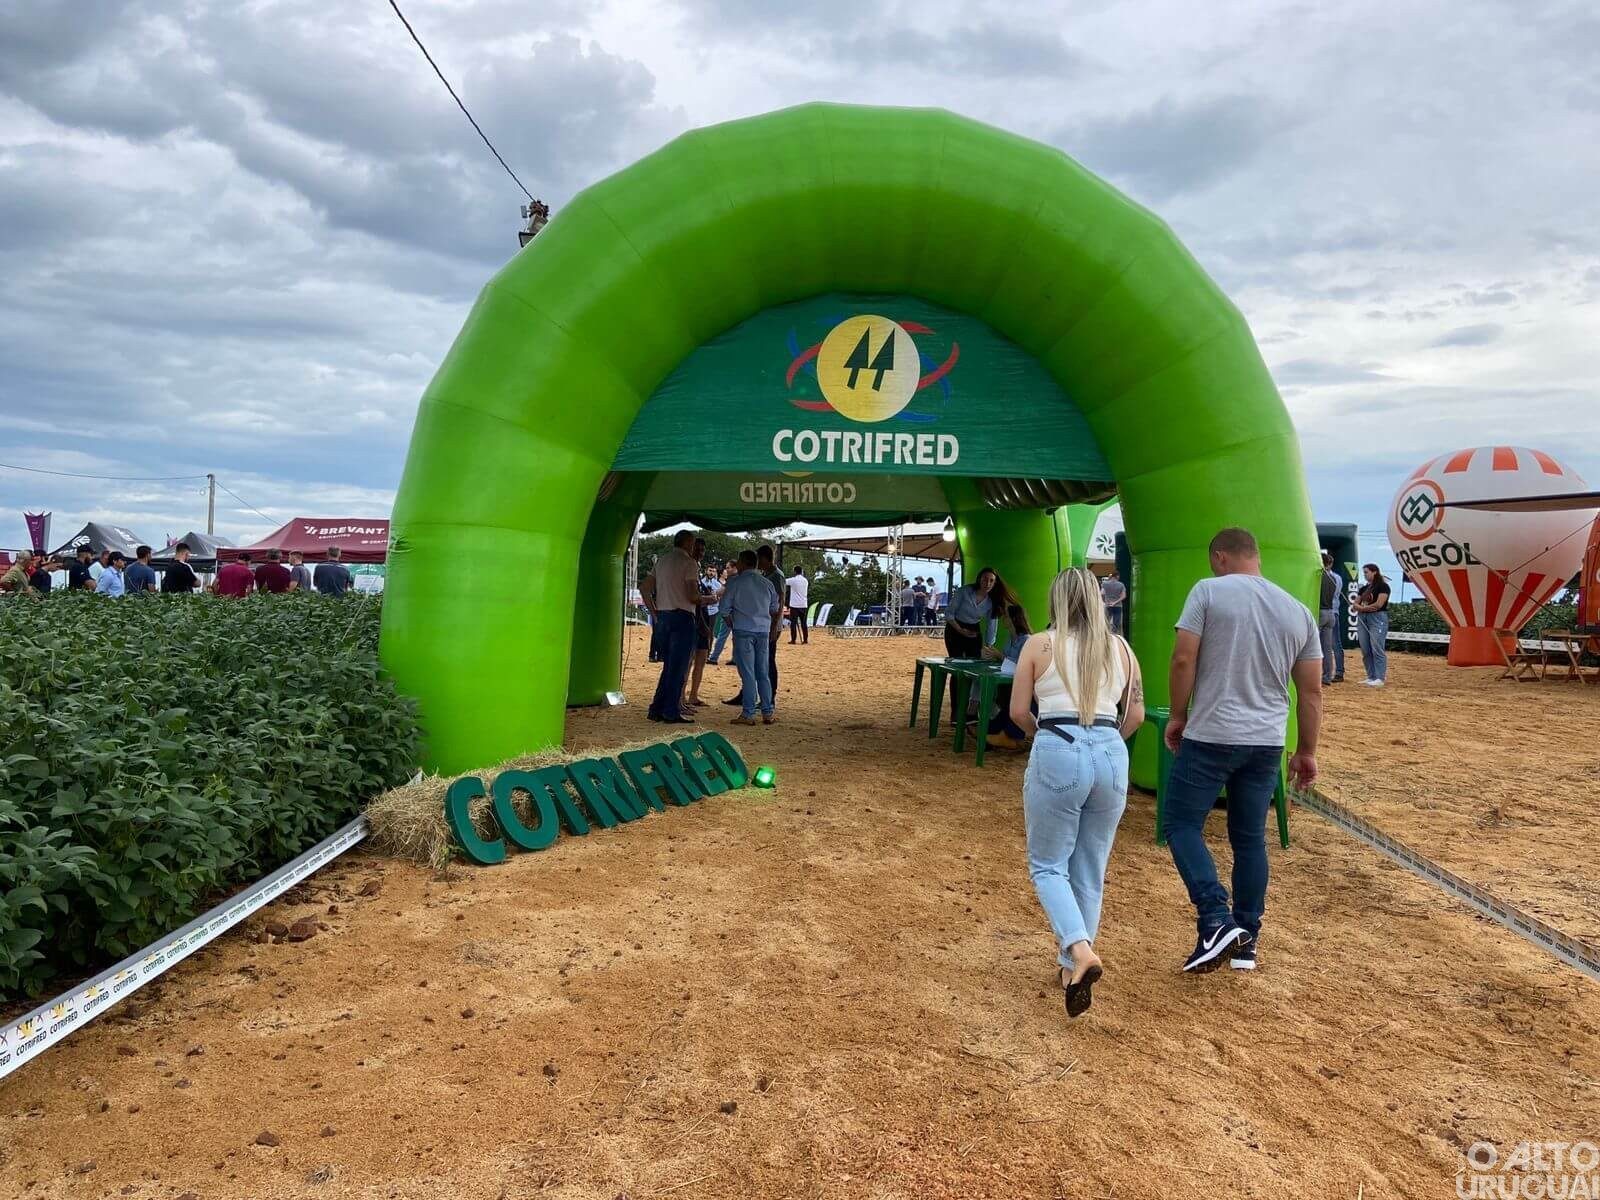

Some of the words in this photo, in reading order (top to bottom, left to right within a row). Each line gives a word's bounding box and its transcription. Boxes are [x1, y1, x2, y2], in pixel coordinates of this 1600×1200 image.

[772, 428, 960, 466] COTRIFRED
[319, 525, 385, 535] BREVANT
[1396, 542, 1481, 573] RESOL
[444, 731, 749, 866] COTRIFRED
[16, 1030, 47, 1056] COTRIFRED
[50, 1011, 78, 1034] COTRIFRED
[83, 991, 110, 1013] COTRIFRED
[113, 973, 138, 993] COTRIFRED
